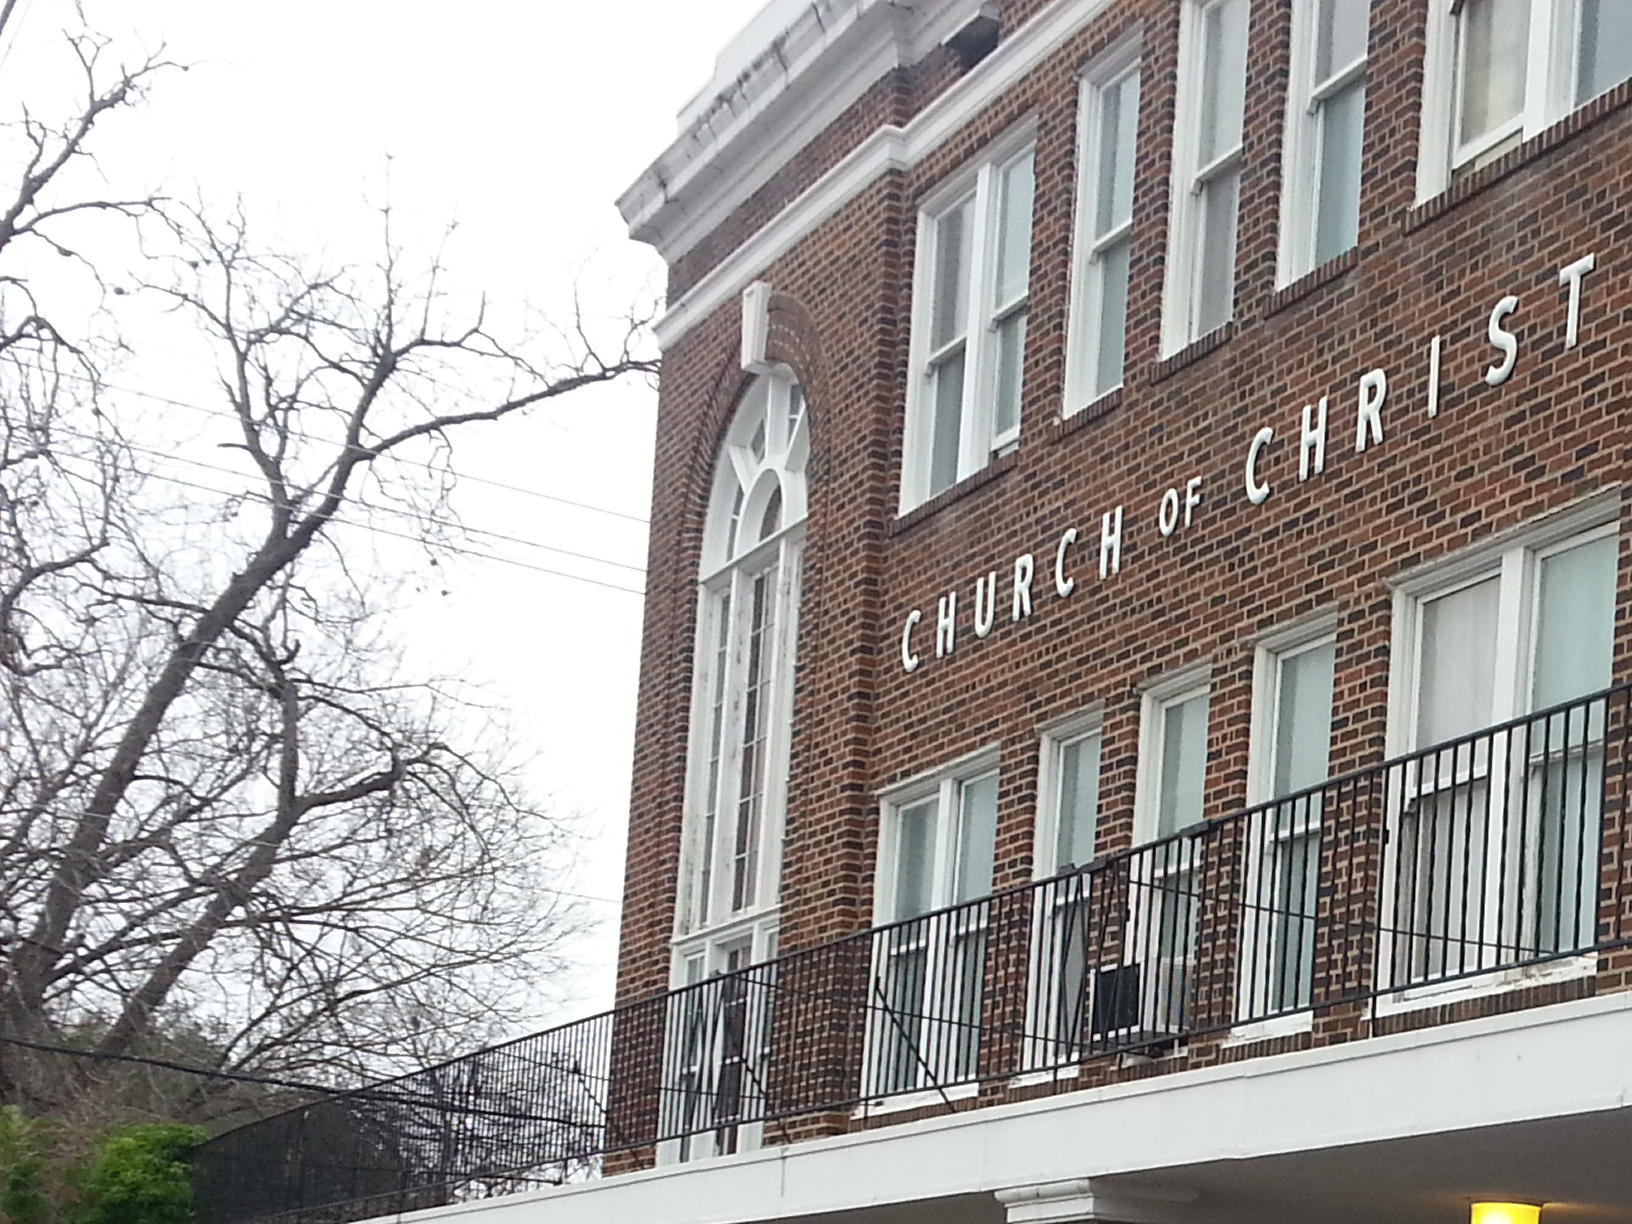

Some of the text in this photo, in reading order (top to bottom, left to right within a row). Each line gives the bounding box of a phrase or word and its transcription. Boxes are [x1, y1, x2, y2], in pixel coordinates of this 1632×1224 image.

[901, 252, 1596, 673] CHURCH OF CHRIST
